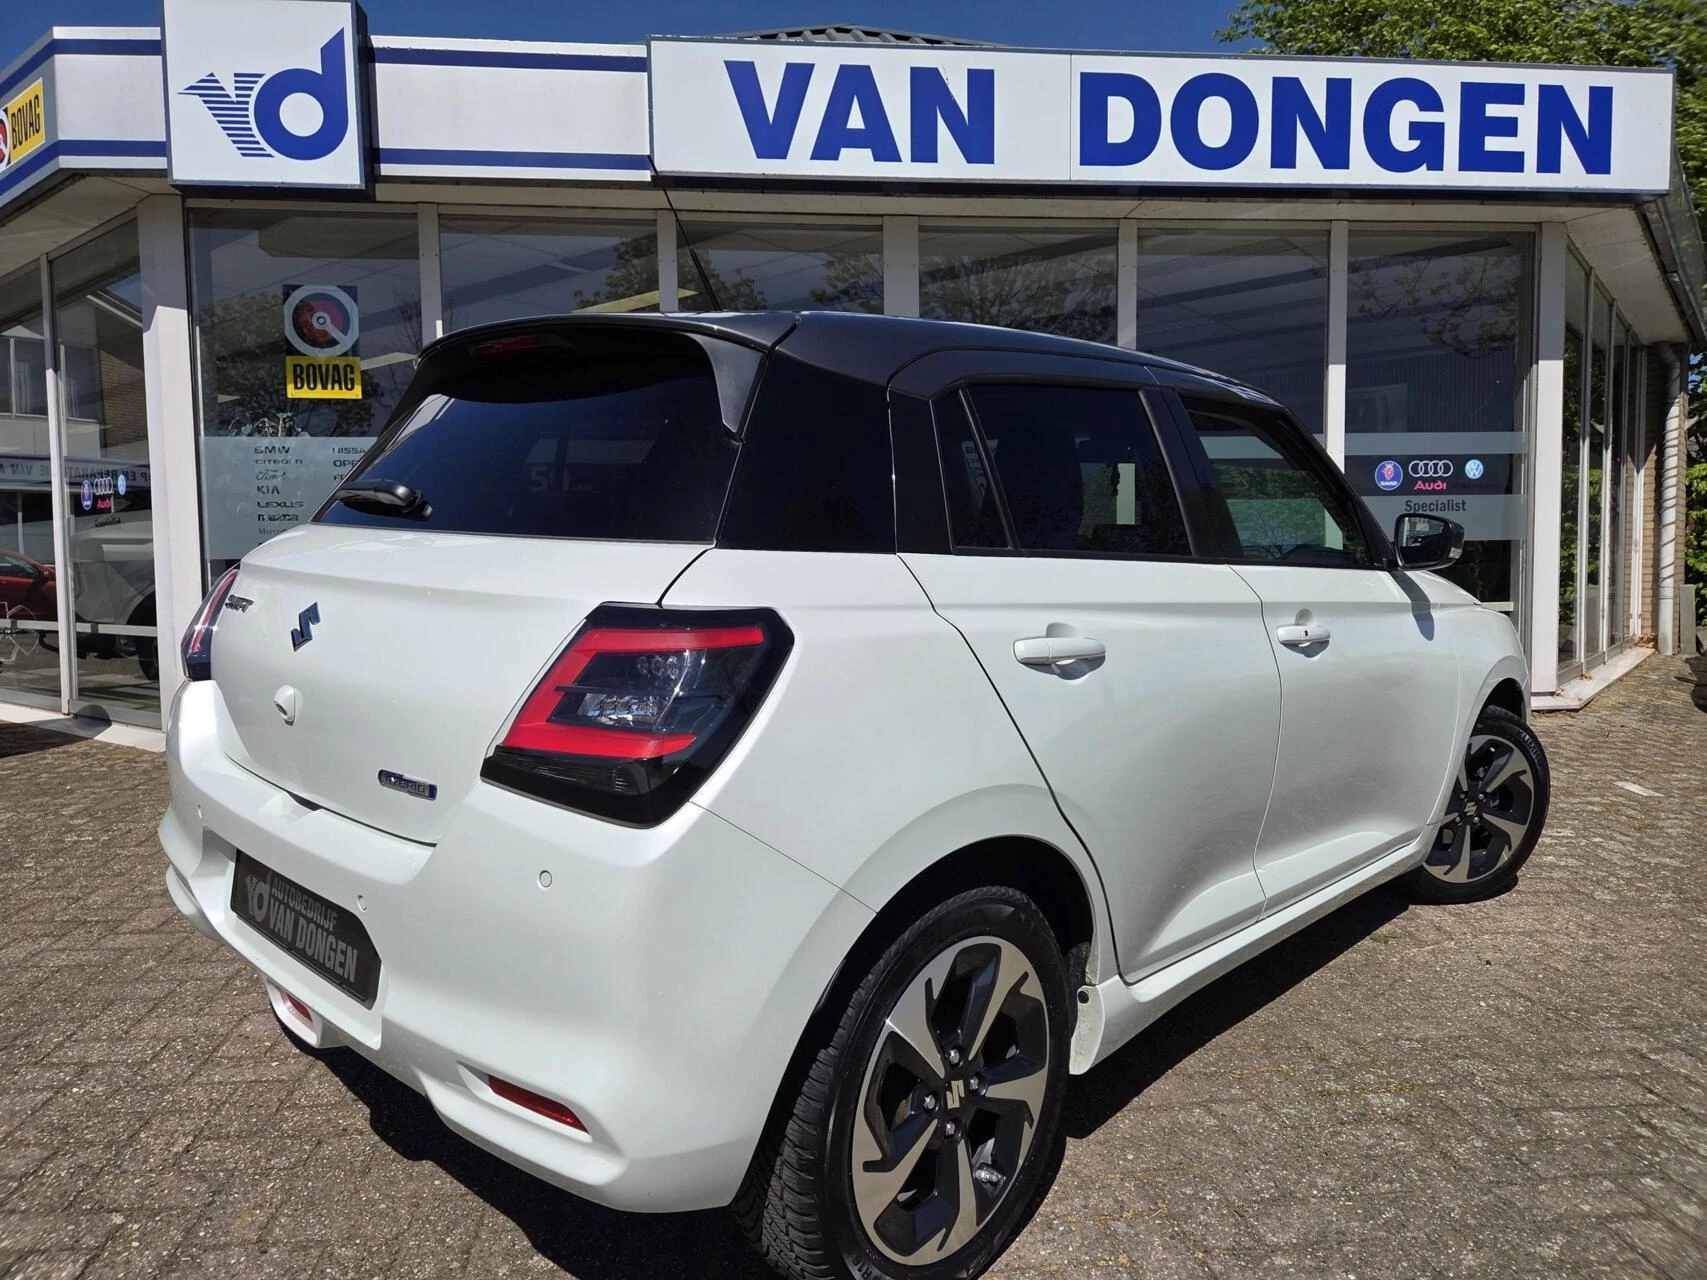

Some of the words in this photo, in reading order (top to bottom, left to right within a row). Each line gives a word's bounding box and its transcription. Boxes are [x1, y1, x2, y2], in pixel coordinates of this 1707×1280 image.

[11, 94, 40, 150] BOVAG
[725, 60, 994, 165] VAN
[1079, 72, 1613, 175] DONGEN
[293, 364, 355, 391] BOVAG
[254, 446, 290, 454] BMW
[333, 459, 359, 467] OPE
[257, 485, 280, 494] KIA
[1413, 480, 1447, 491] Audi
[1404, 500, 1466, 513] Specialist
[271, 877, 338, 931] AUTOBEDRIJF
[268, 897, 295, 942] VAN
[295, 918, 358, 983] DONGEN
